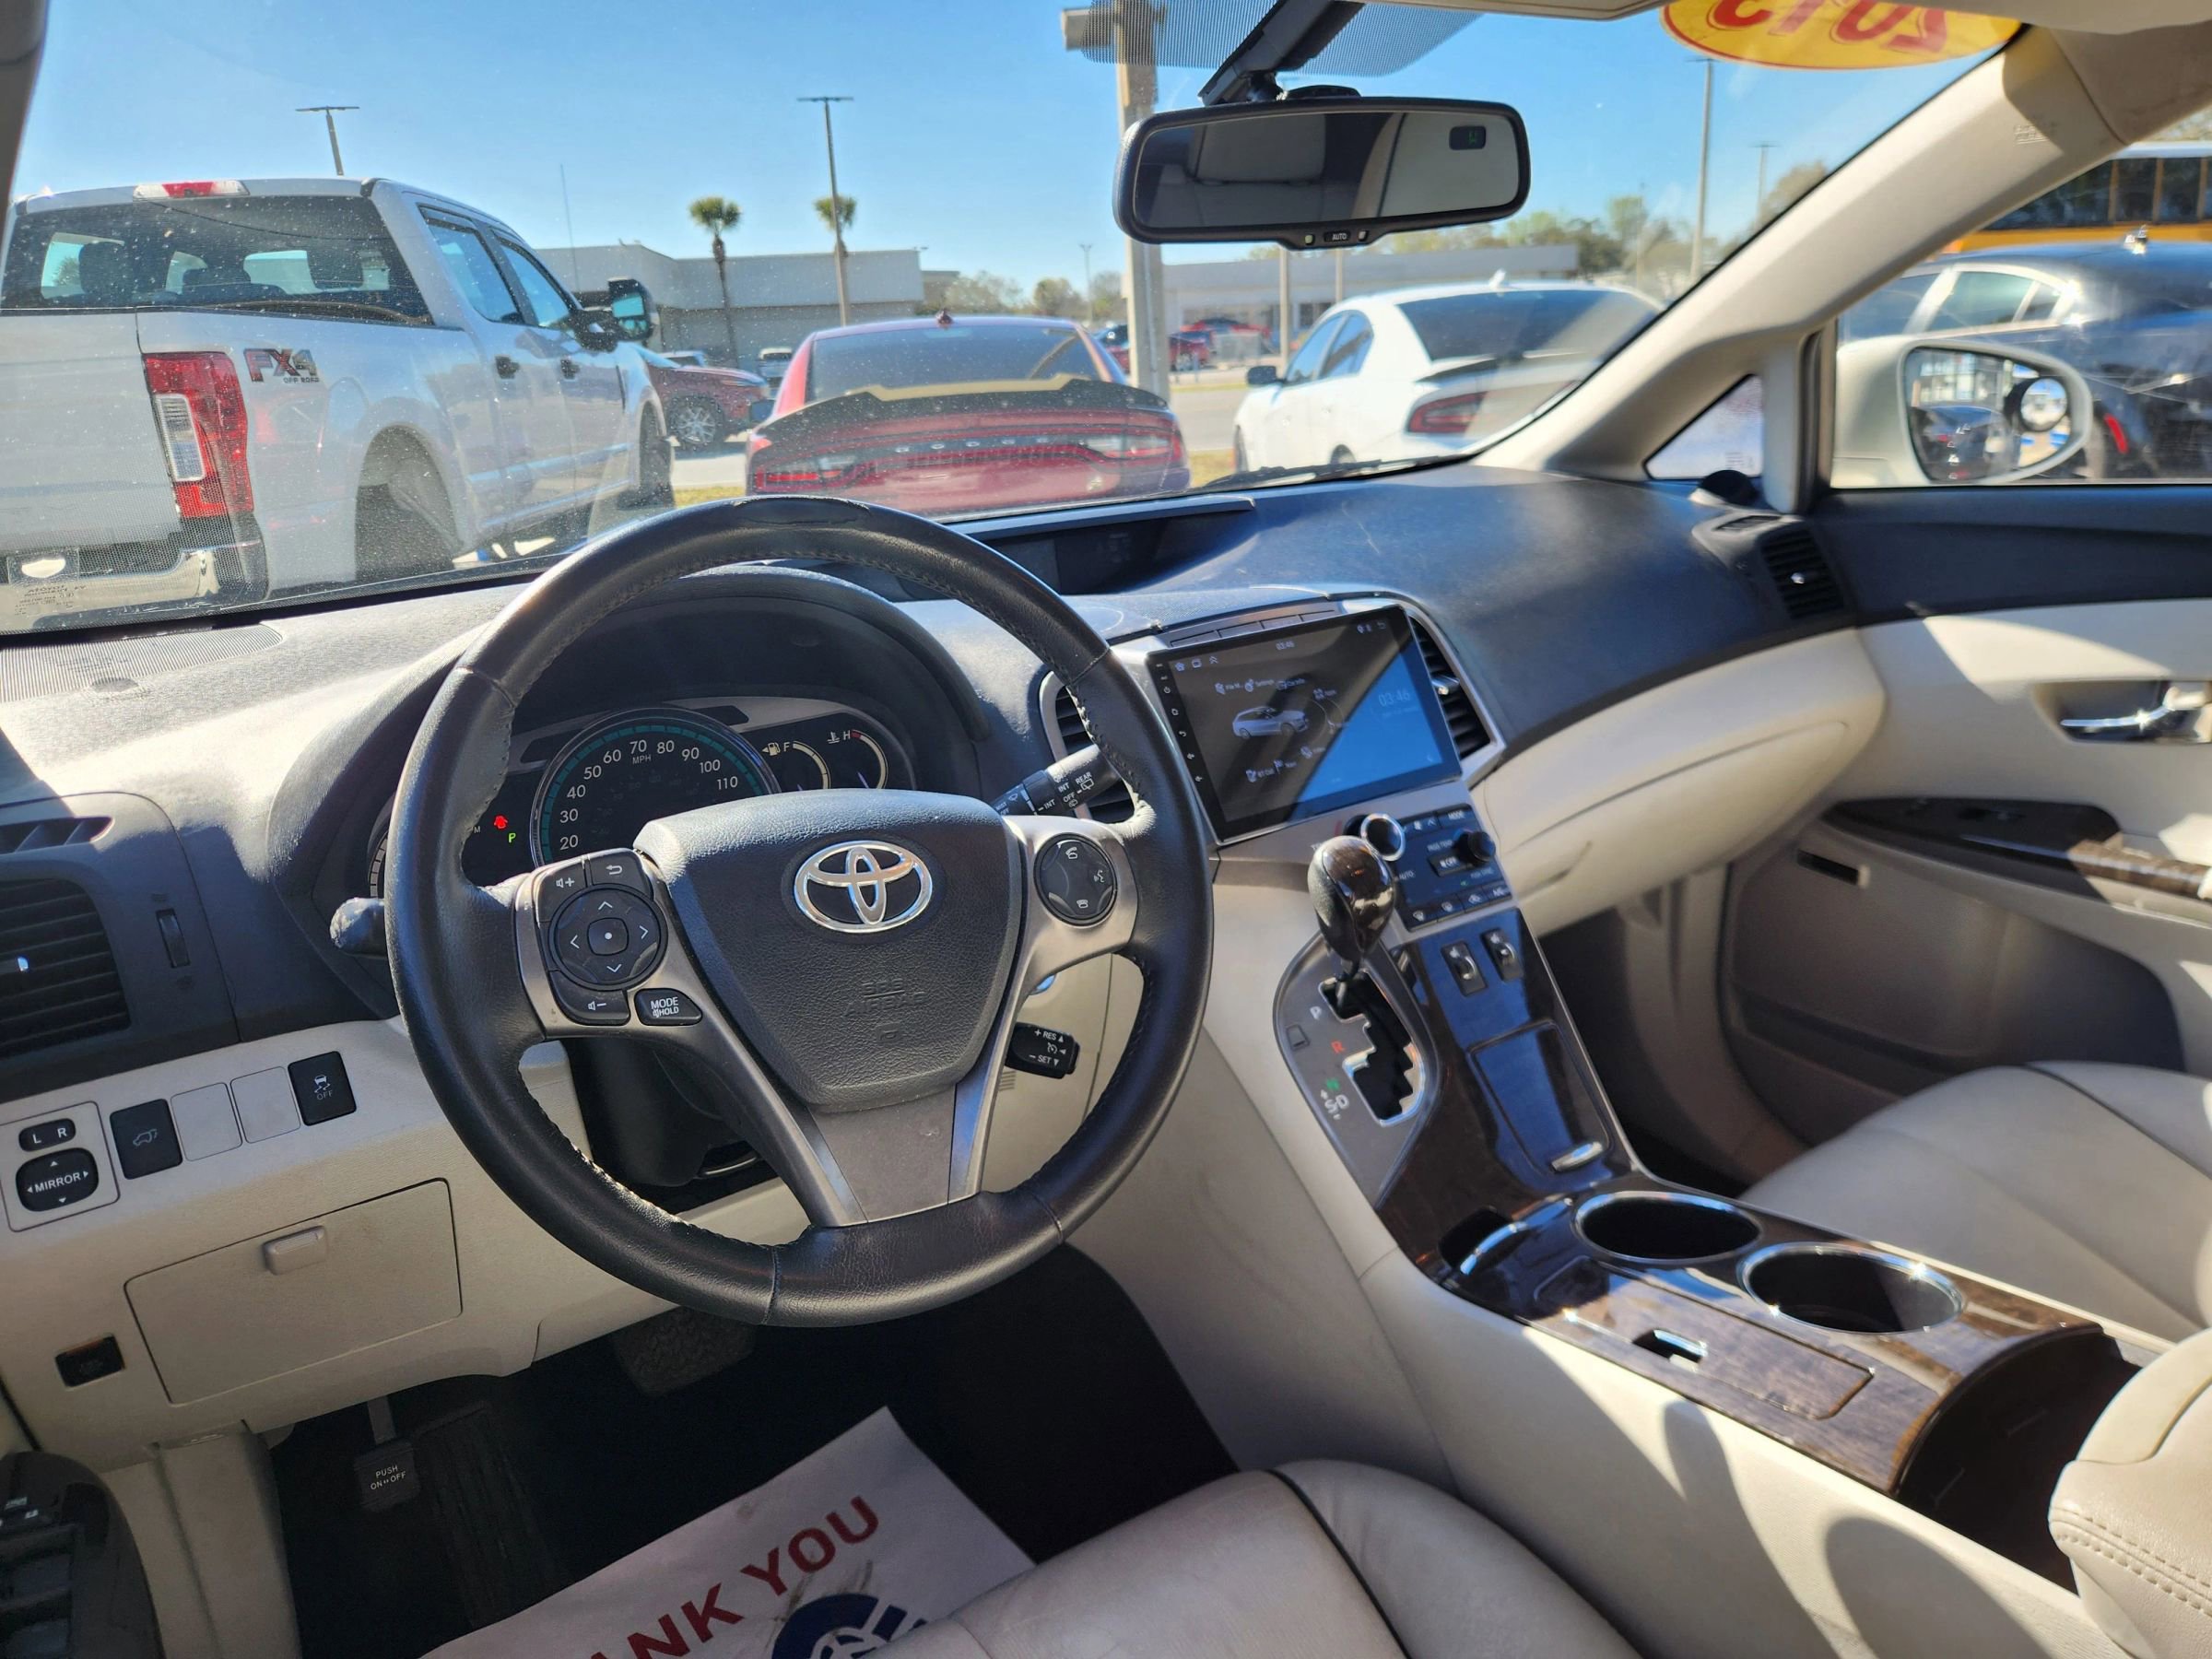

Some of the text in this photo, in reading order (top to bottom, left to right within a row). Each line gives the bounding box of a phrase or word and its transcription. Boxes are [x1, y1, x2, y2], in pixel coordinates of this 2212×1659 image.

[1332, 233, 1348, 241] AUTO
[243, 348, 318, 382] FX4
[843, 730, 850, 741] H
[629, 739, 647, 755] 70
[657, 740, 675, 754] 80
[783, 742, 790, 752] F
[603, 749, 622, 764] 60
[632, 755, 652, 765] MPH
[681, 747, 700, 761] 90
[583, 765, 602, 780] 50
[700, 759, 721, 774] 100
[717, 776, 738, 791] 110
[1075, 771, 1092, 785] REAR
[567, 784, 586, 799] 40
[1058, 782, 1070, 793] INT
[1063, 792, 1076, 803] OFF
[1043, 799, 1056, 810] INT
[559, 808, 579, 824] 30
[508, 832, 516, 843] P
[559, 834, 579, 851] 20
[651, 996, 679, 1010] MODE
[659, 1006, 679, 1017] HOLD
[1310, 1006, 1322, 1020] P
[1042, 1030, 1057, 1041] RES
[1037, 1054, 1053, 1065] SET
[317, 1089, 333, 1100] OFF
[32, 1134, 41, 1144] L
[57, 1127, 67, 1138] R
[34, 1171, 82, 1193] MIRROR
[375, 1465, 398, 1478] PUSH
[391, 1470, 406, 1483] OFF
[740, 1496, 879, 1596] YOU
